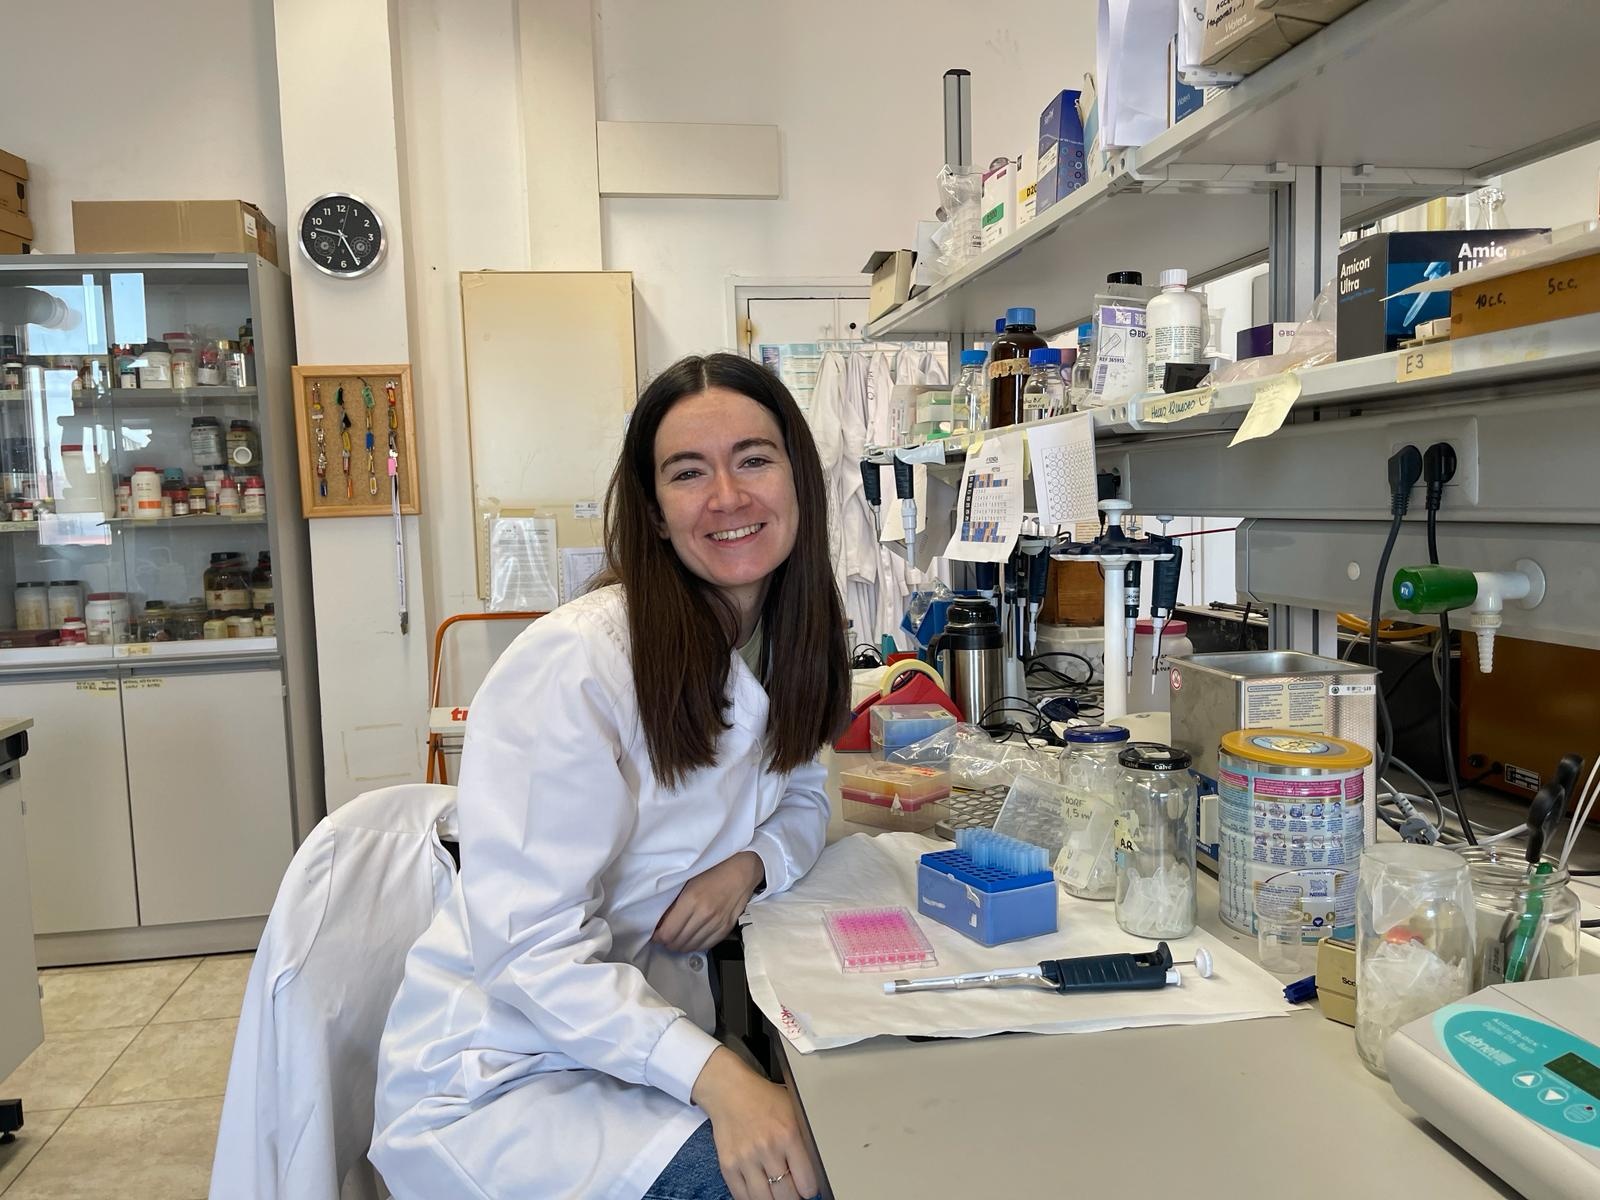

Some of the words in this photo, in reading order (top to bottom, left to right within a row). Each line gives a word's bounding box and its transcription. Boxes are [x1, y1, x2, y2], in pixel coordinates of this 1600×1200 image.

[323, 208, 331, 216] 11
[336, 204, 346, 213] 12
[353, 209, 358, 217] 1
[311, 217, 322, 226] 10
[364, 219, 370, 227] 2
[310, 231, 317, 239] 9
[368, 233, 374, 241] 3
[326, 256, 333, 264] 7
[340, 260, 347, 268] 6
[1340, 257, 1371, 279] Amicon
[1340, 278, 1360, 295] Ultra
[1137, 331, 1147, 339] BD
